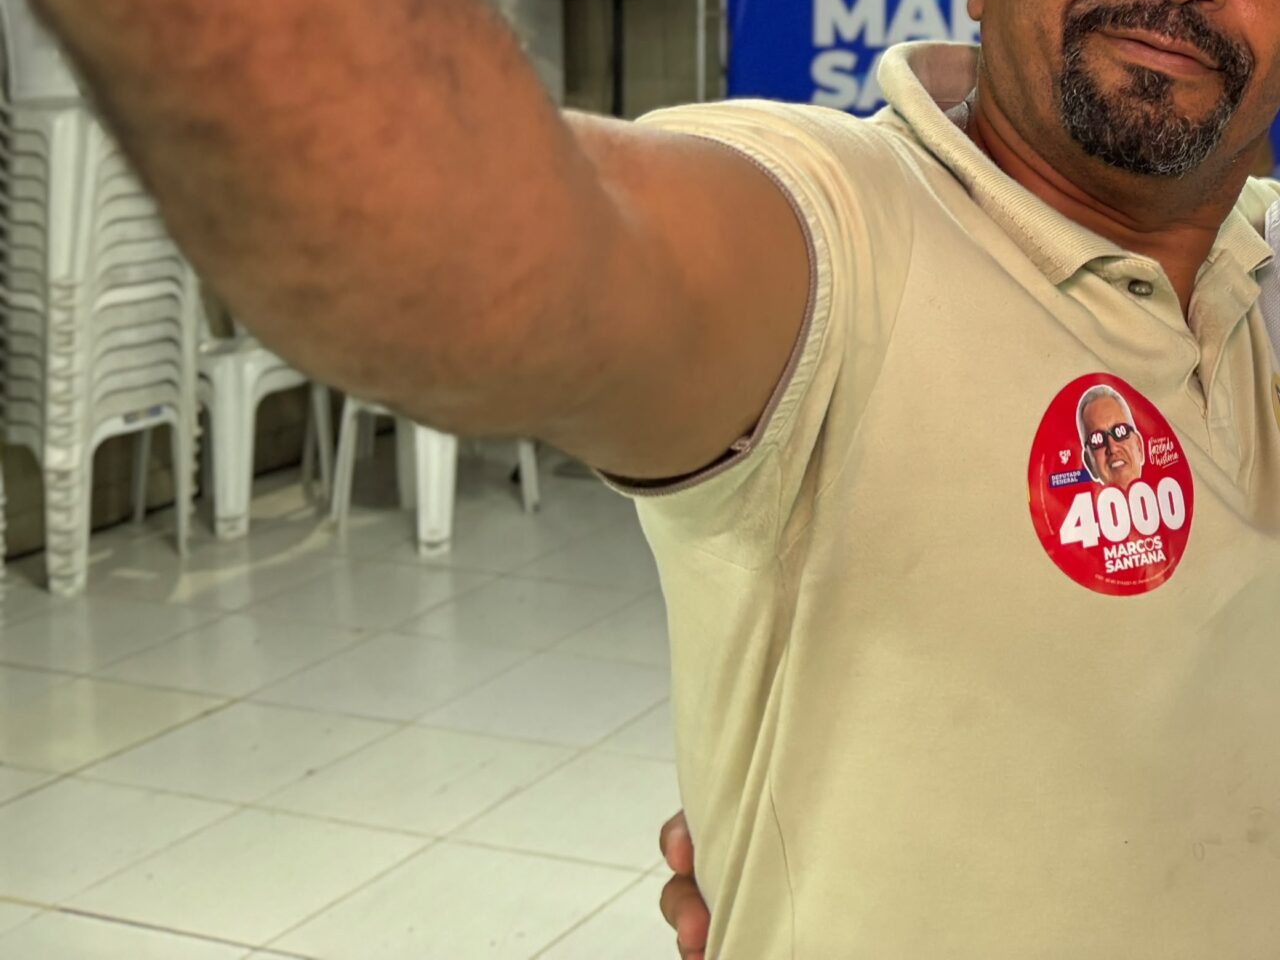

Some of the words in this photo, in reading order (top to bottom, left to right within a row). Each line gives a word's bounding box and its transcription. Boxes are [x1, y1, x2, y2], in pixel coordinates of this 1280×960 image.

[1091, 433, 1104, 445] 40
[1114, 427, 1127, 438] 00
[1060, 476, 1186, 548] 4000
[1103, 536, 1163, 561] MARCOS
[1105, 549, 1167, 573] SANTANA
